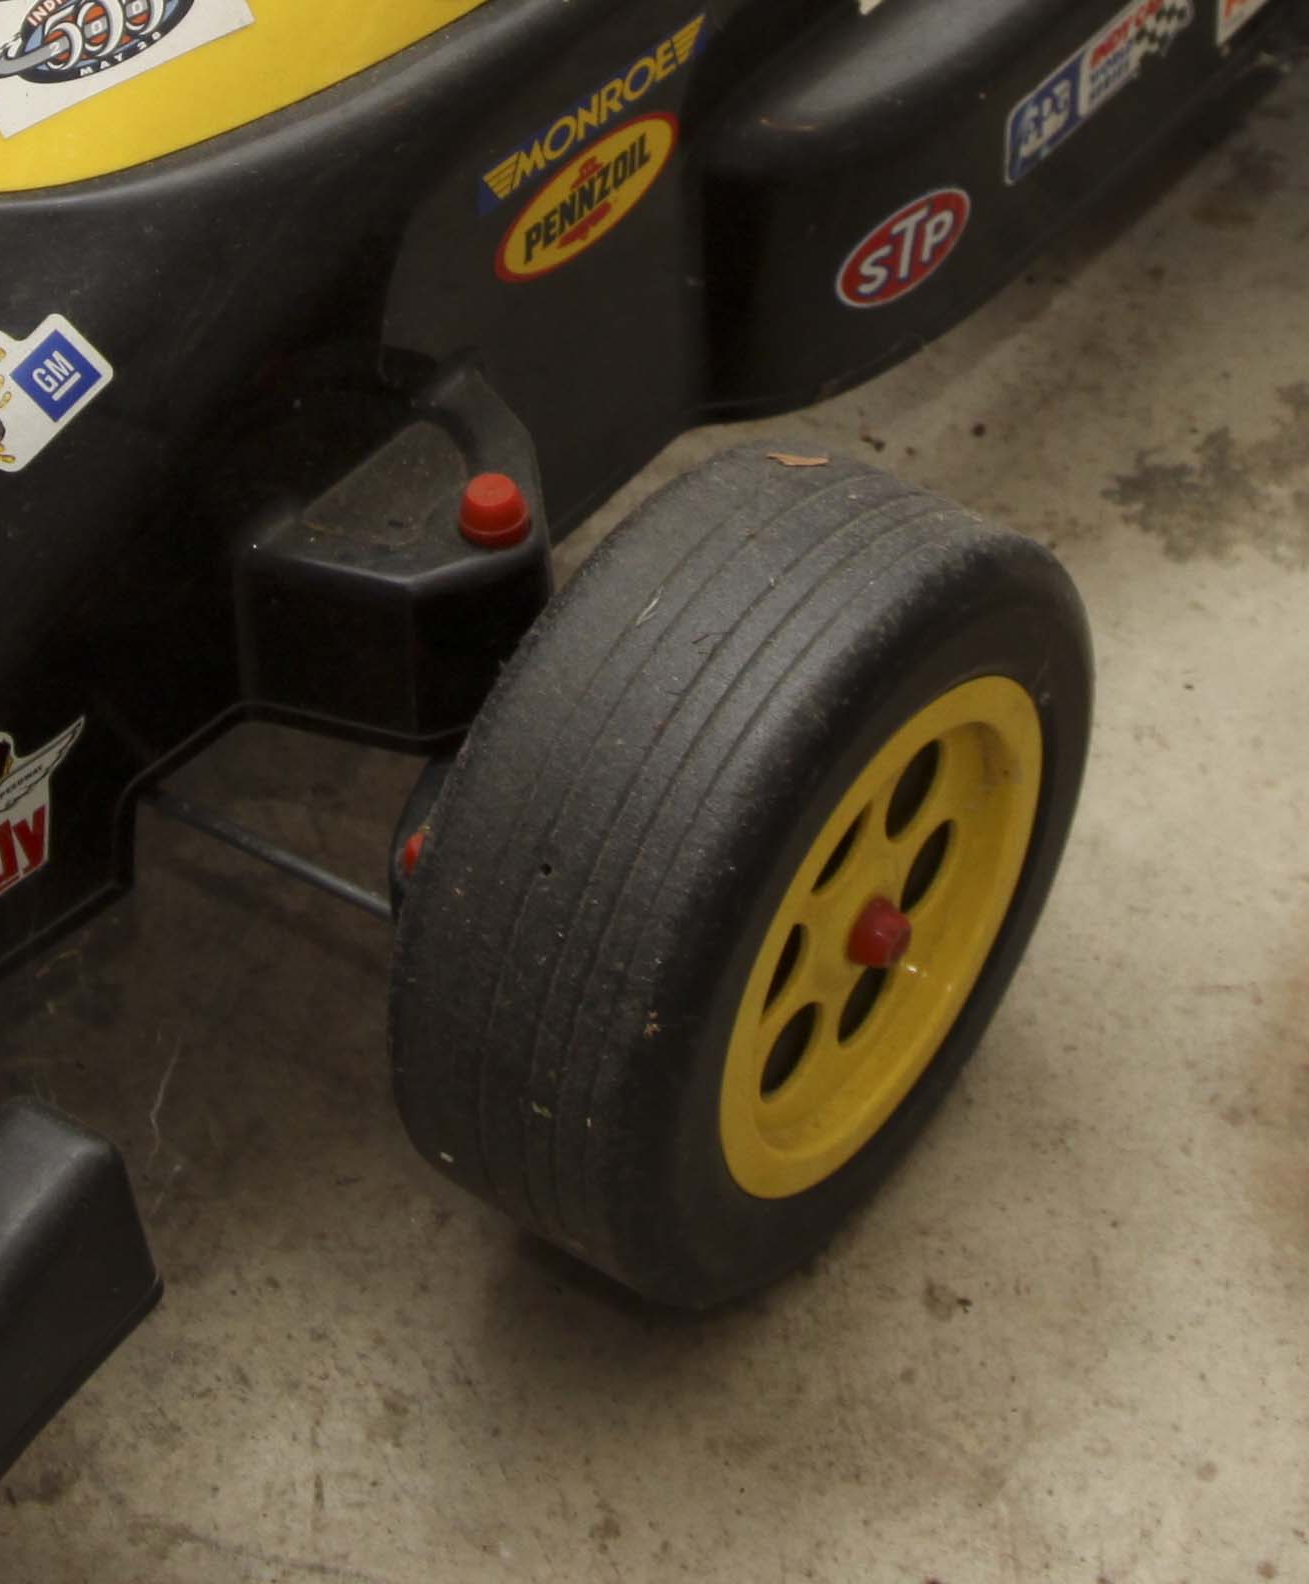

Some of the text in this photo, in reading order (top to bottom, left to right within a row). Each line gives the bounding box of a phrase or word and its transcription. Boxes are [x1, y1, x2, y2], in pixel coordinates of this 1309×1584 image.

[79, 52, 124, 77] MAY
[510, 38, 678, 191] MONROE
[522, 132, 651, 265] PENNZOIL
[856, 203, 955, 296] STP
[31, 351, 76, 393] GM
